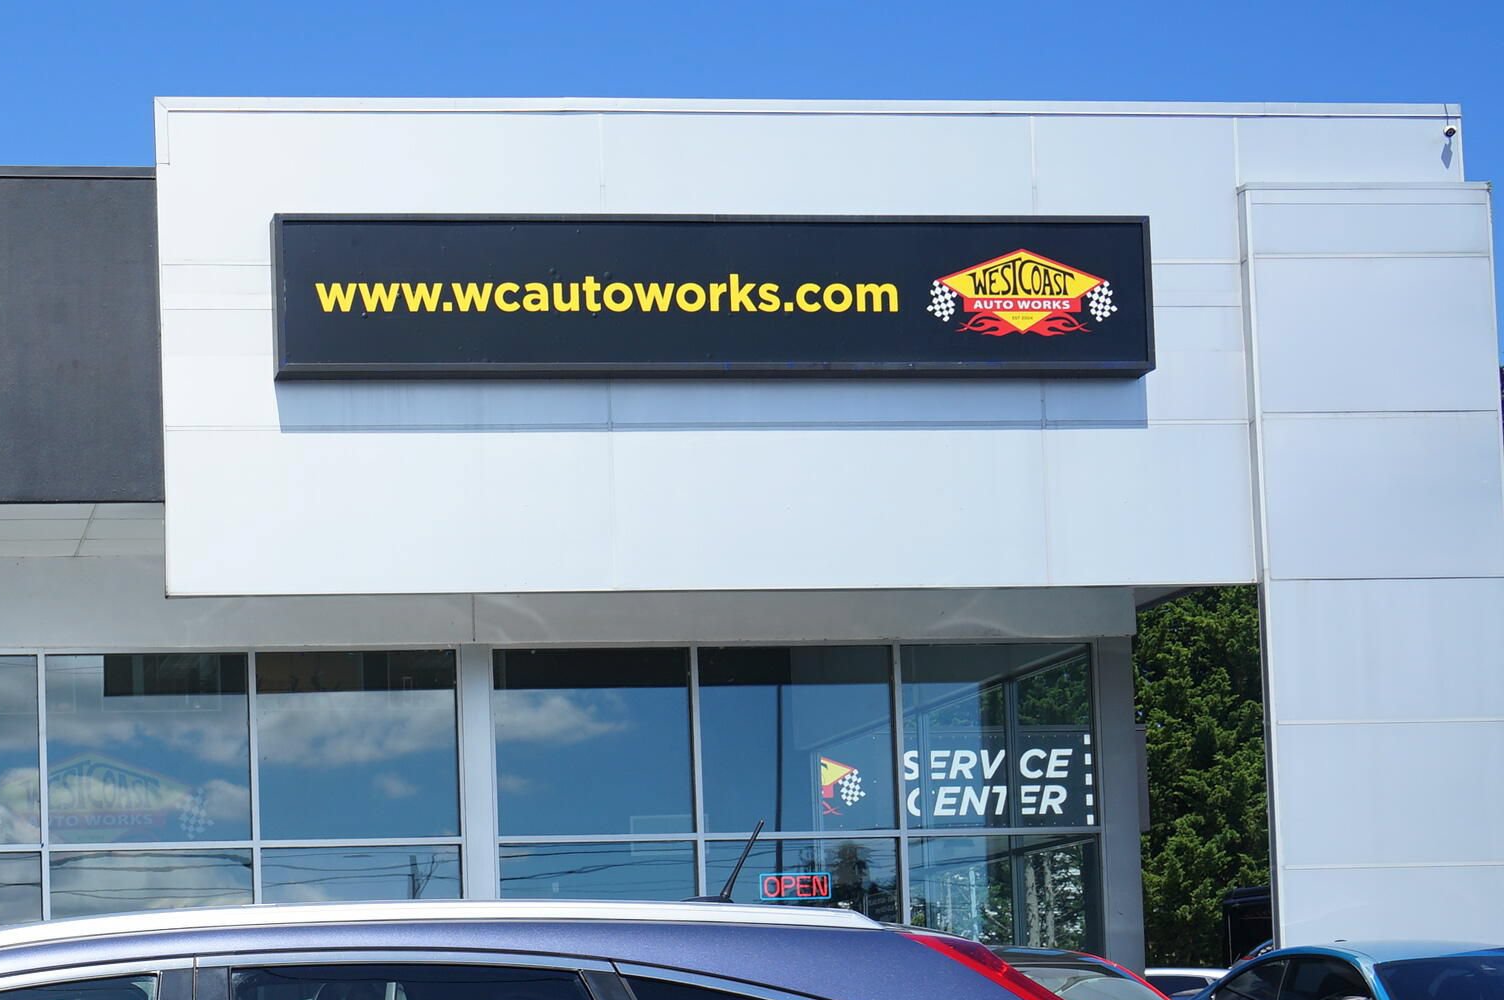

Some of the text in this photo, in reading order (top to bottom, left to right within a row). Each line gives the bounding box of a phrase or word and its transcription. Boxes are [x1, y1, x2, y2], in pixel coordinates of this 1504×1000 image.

[968, 257, 1076, 296] WESTCOAST
[316, 274, 898, 312] www.wcautoworks.com
[973, 299, 1071, 309] AUTO WORKS
[904, 748, 1073, 780] SERVCE
[84, 814, 153, 825] WORKS
[764, 875, 828, 897] OPEN
